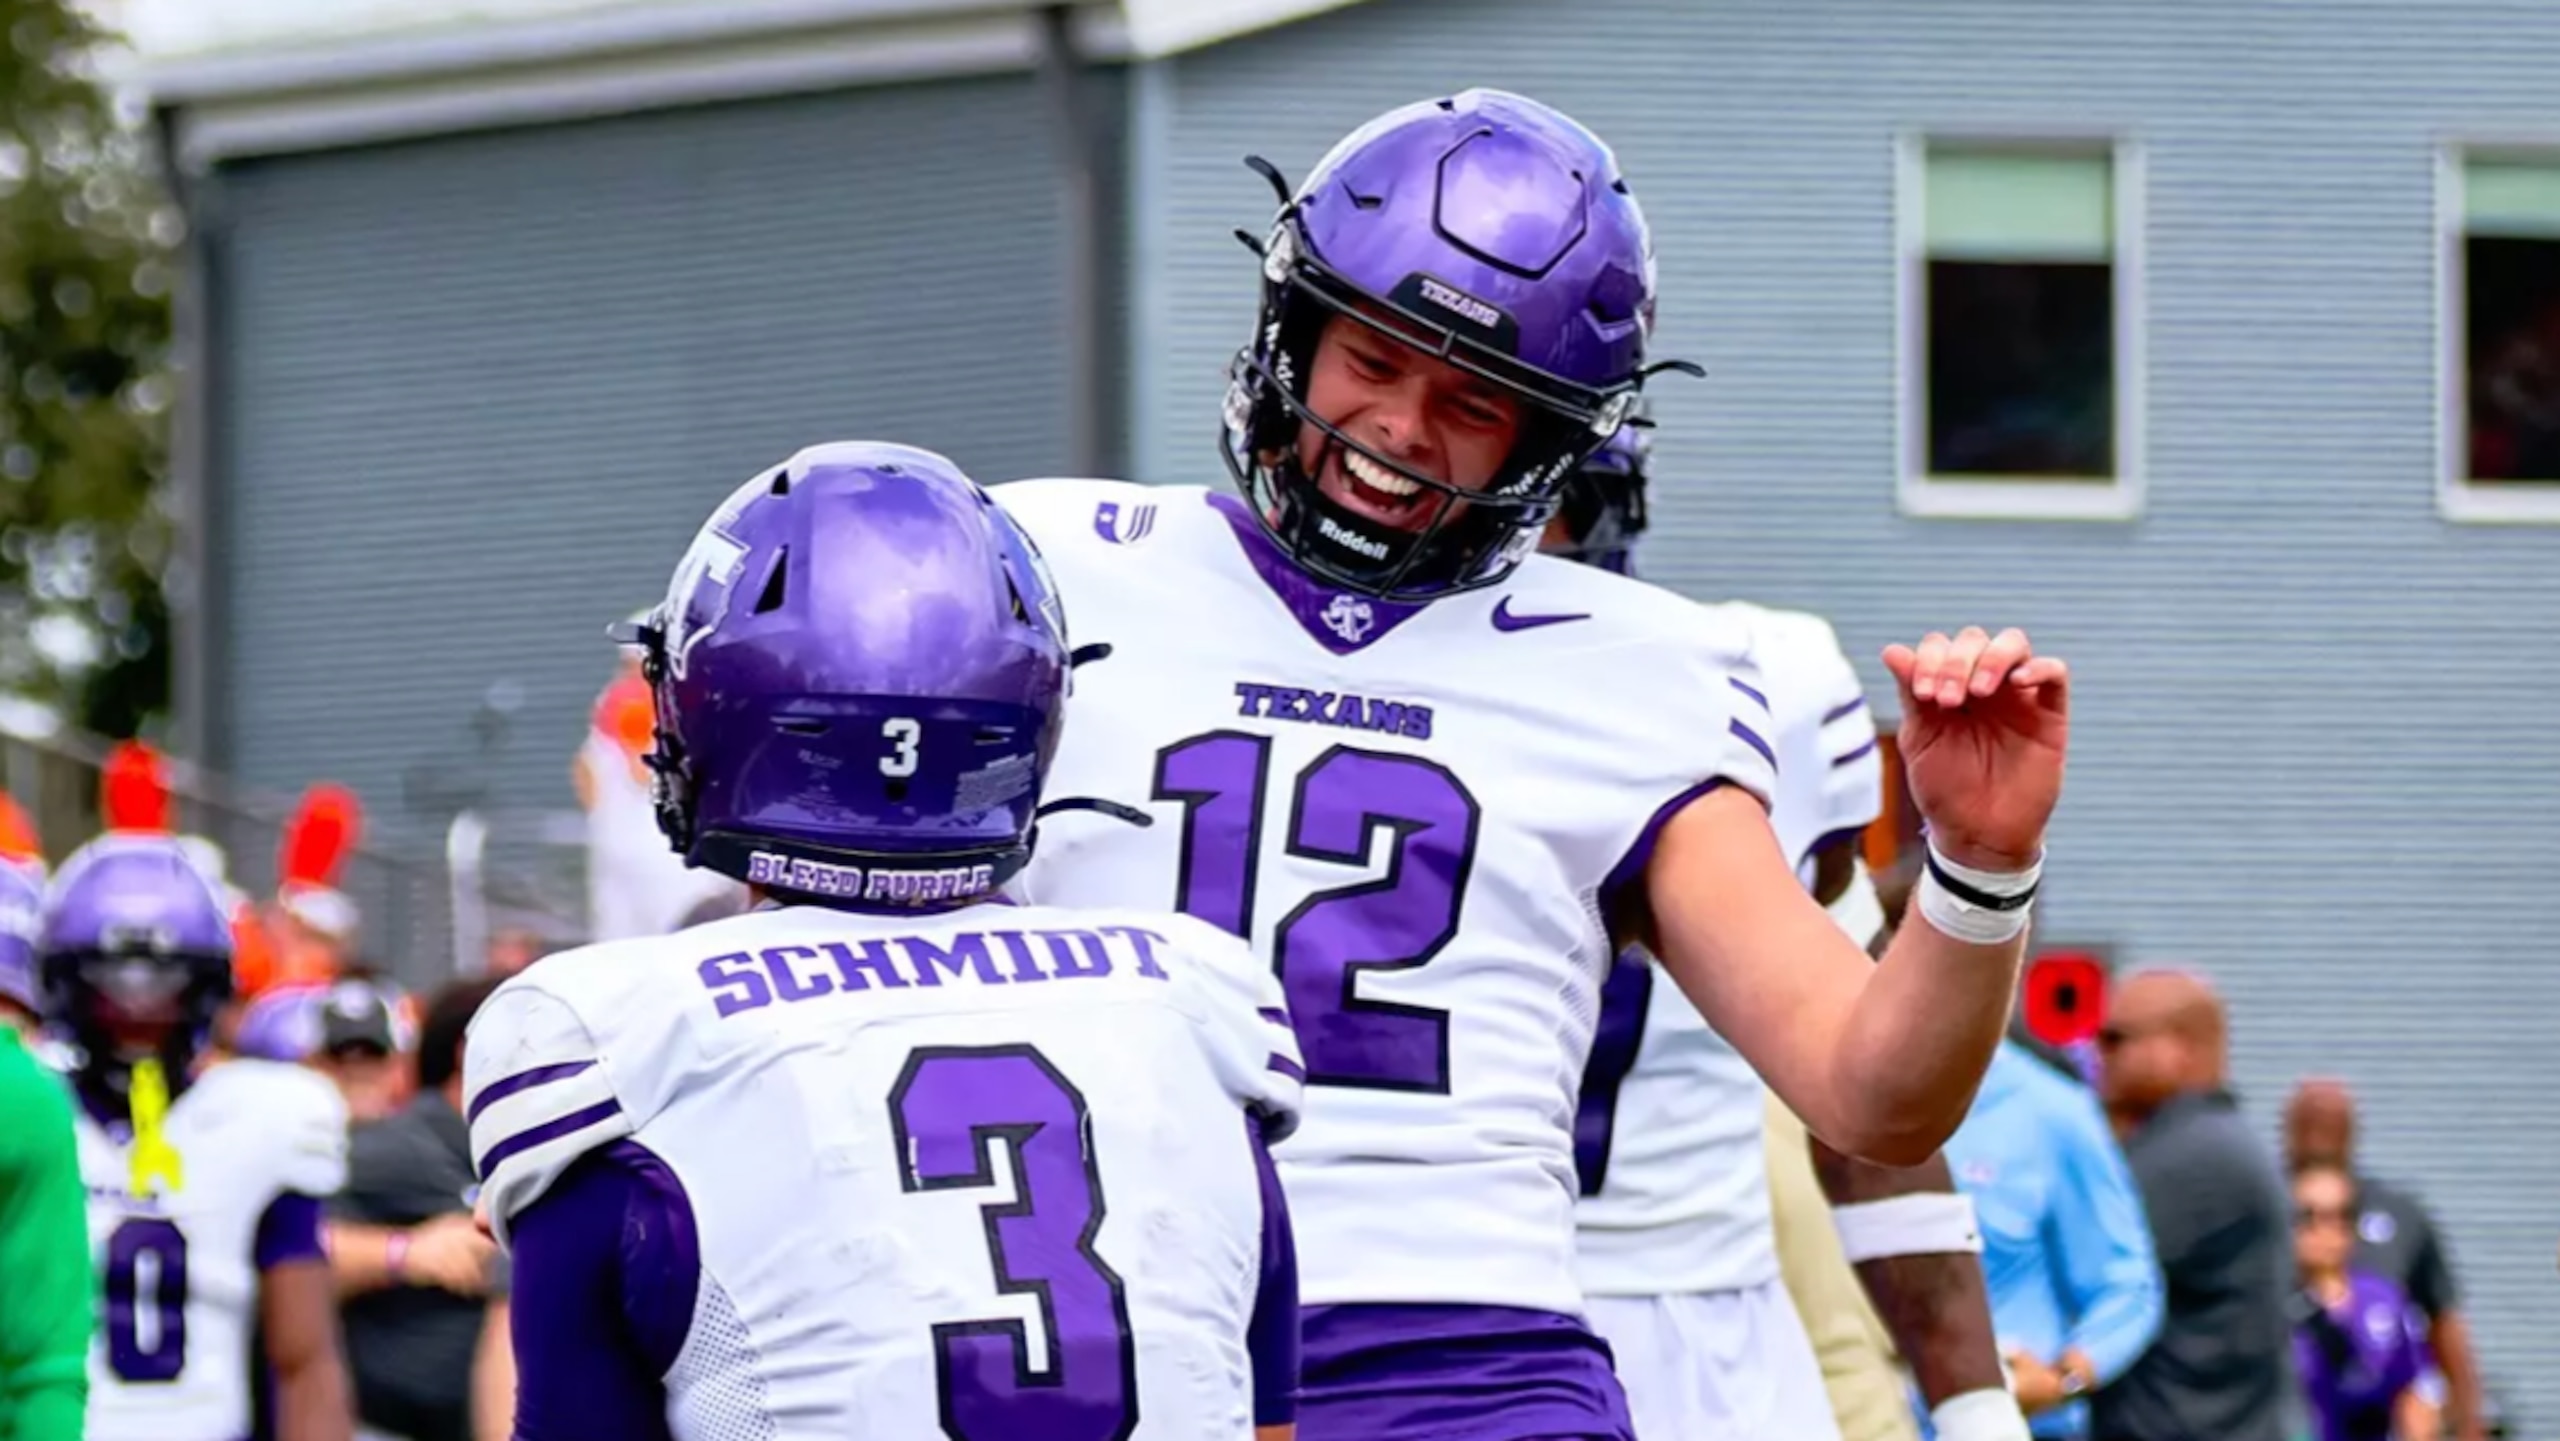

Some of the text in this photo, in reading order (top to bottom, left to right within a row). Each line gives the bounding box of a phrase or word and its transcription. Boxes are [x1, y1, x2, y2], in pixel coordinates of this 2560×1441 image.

[1319, 517, 1389, 560] Riddell
[879, 717, 922, 777] 3
[1234, 681, 1434, 741] TEXANS
[748, 850, 994, 900] BLEED PURPLE
[1151, 728, 1481, 1095] 12
[697, 925, 1170, 1018] SCHMIDT
[886, 1042, 1140, 1441] 3
[105, 1216, 188, 1384] 0
